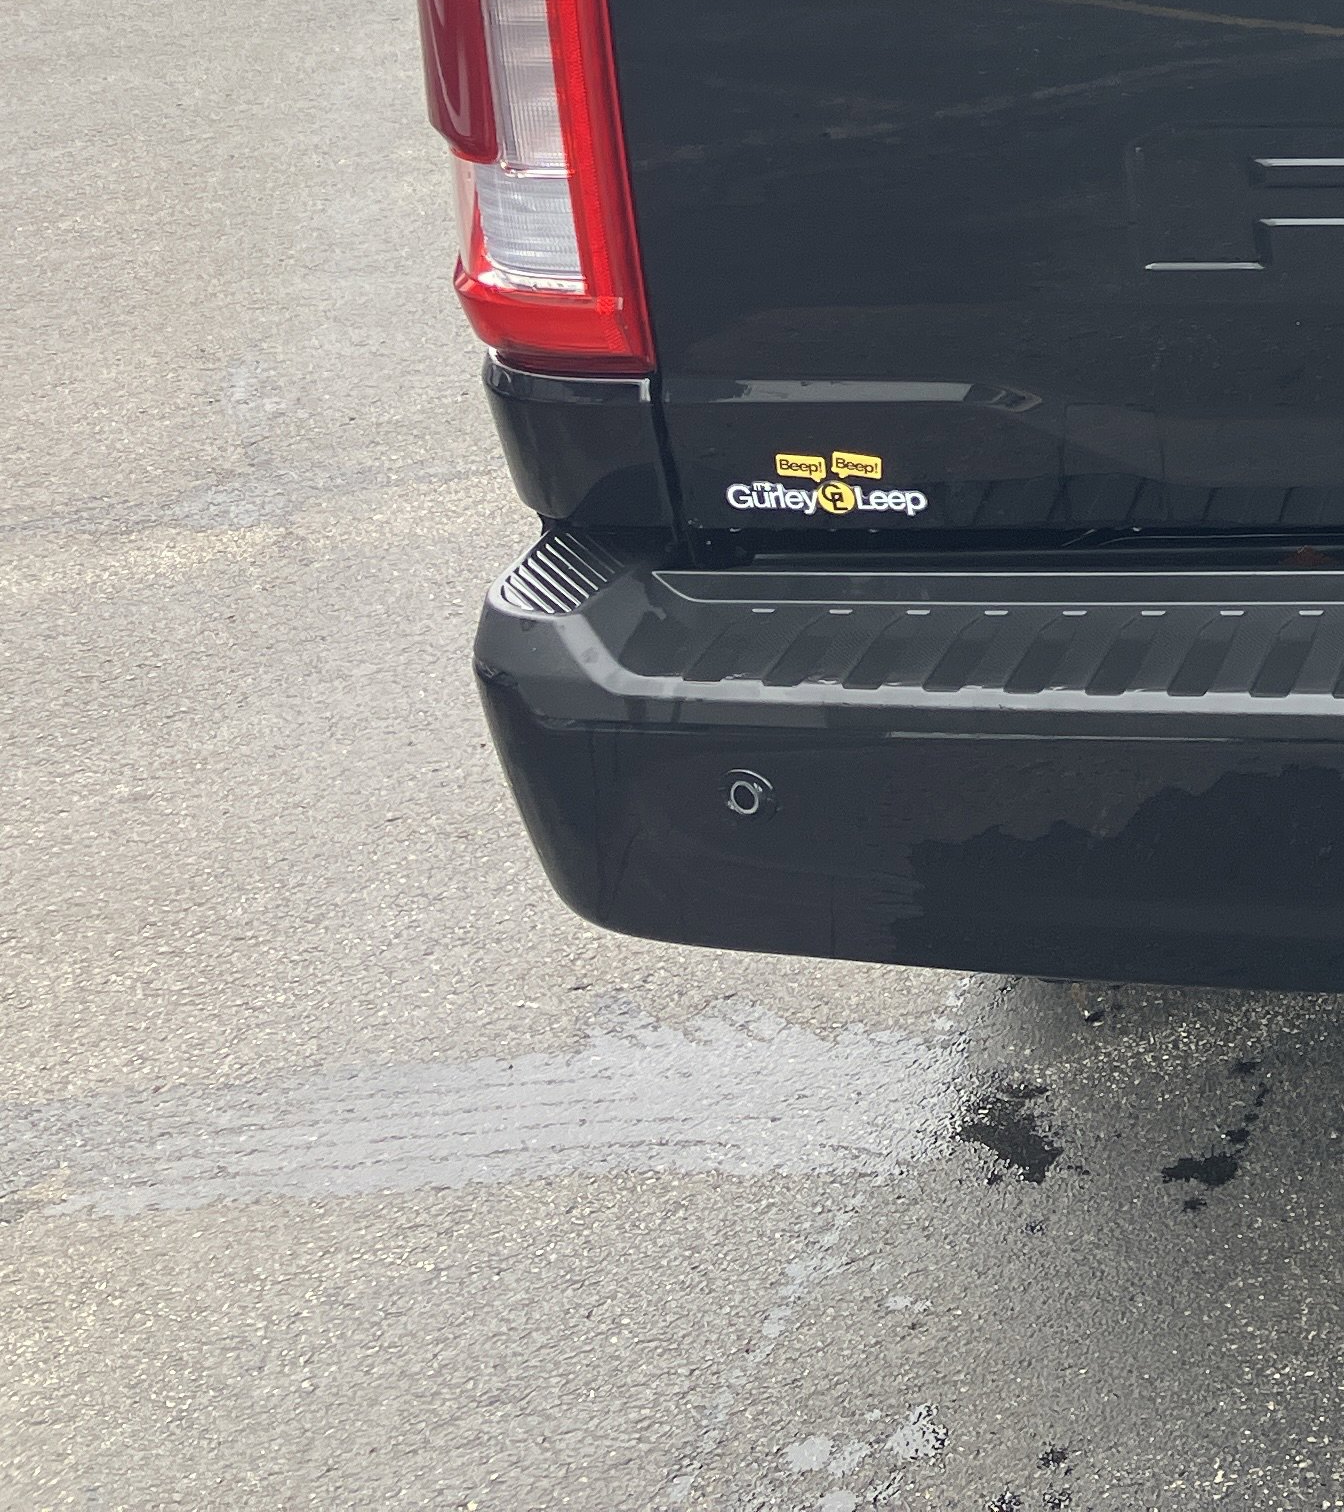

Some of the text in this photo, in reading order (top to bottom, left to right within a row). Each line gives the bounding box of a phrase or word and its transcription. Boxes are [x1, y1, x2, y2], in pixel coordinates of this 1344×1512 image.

[778, 456, 879, 476] Beep! Beep!
[726, 482, 818, 515] Gurley
[854, 484, 928, 516] Leep
